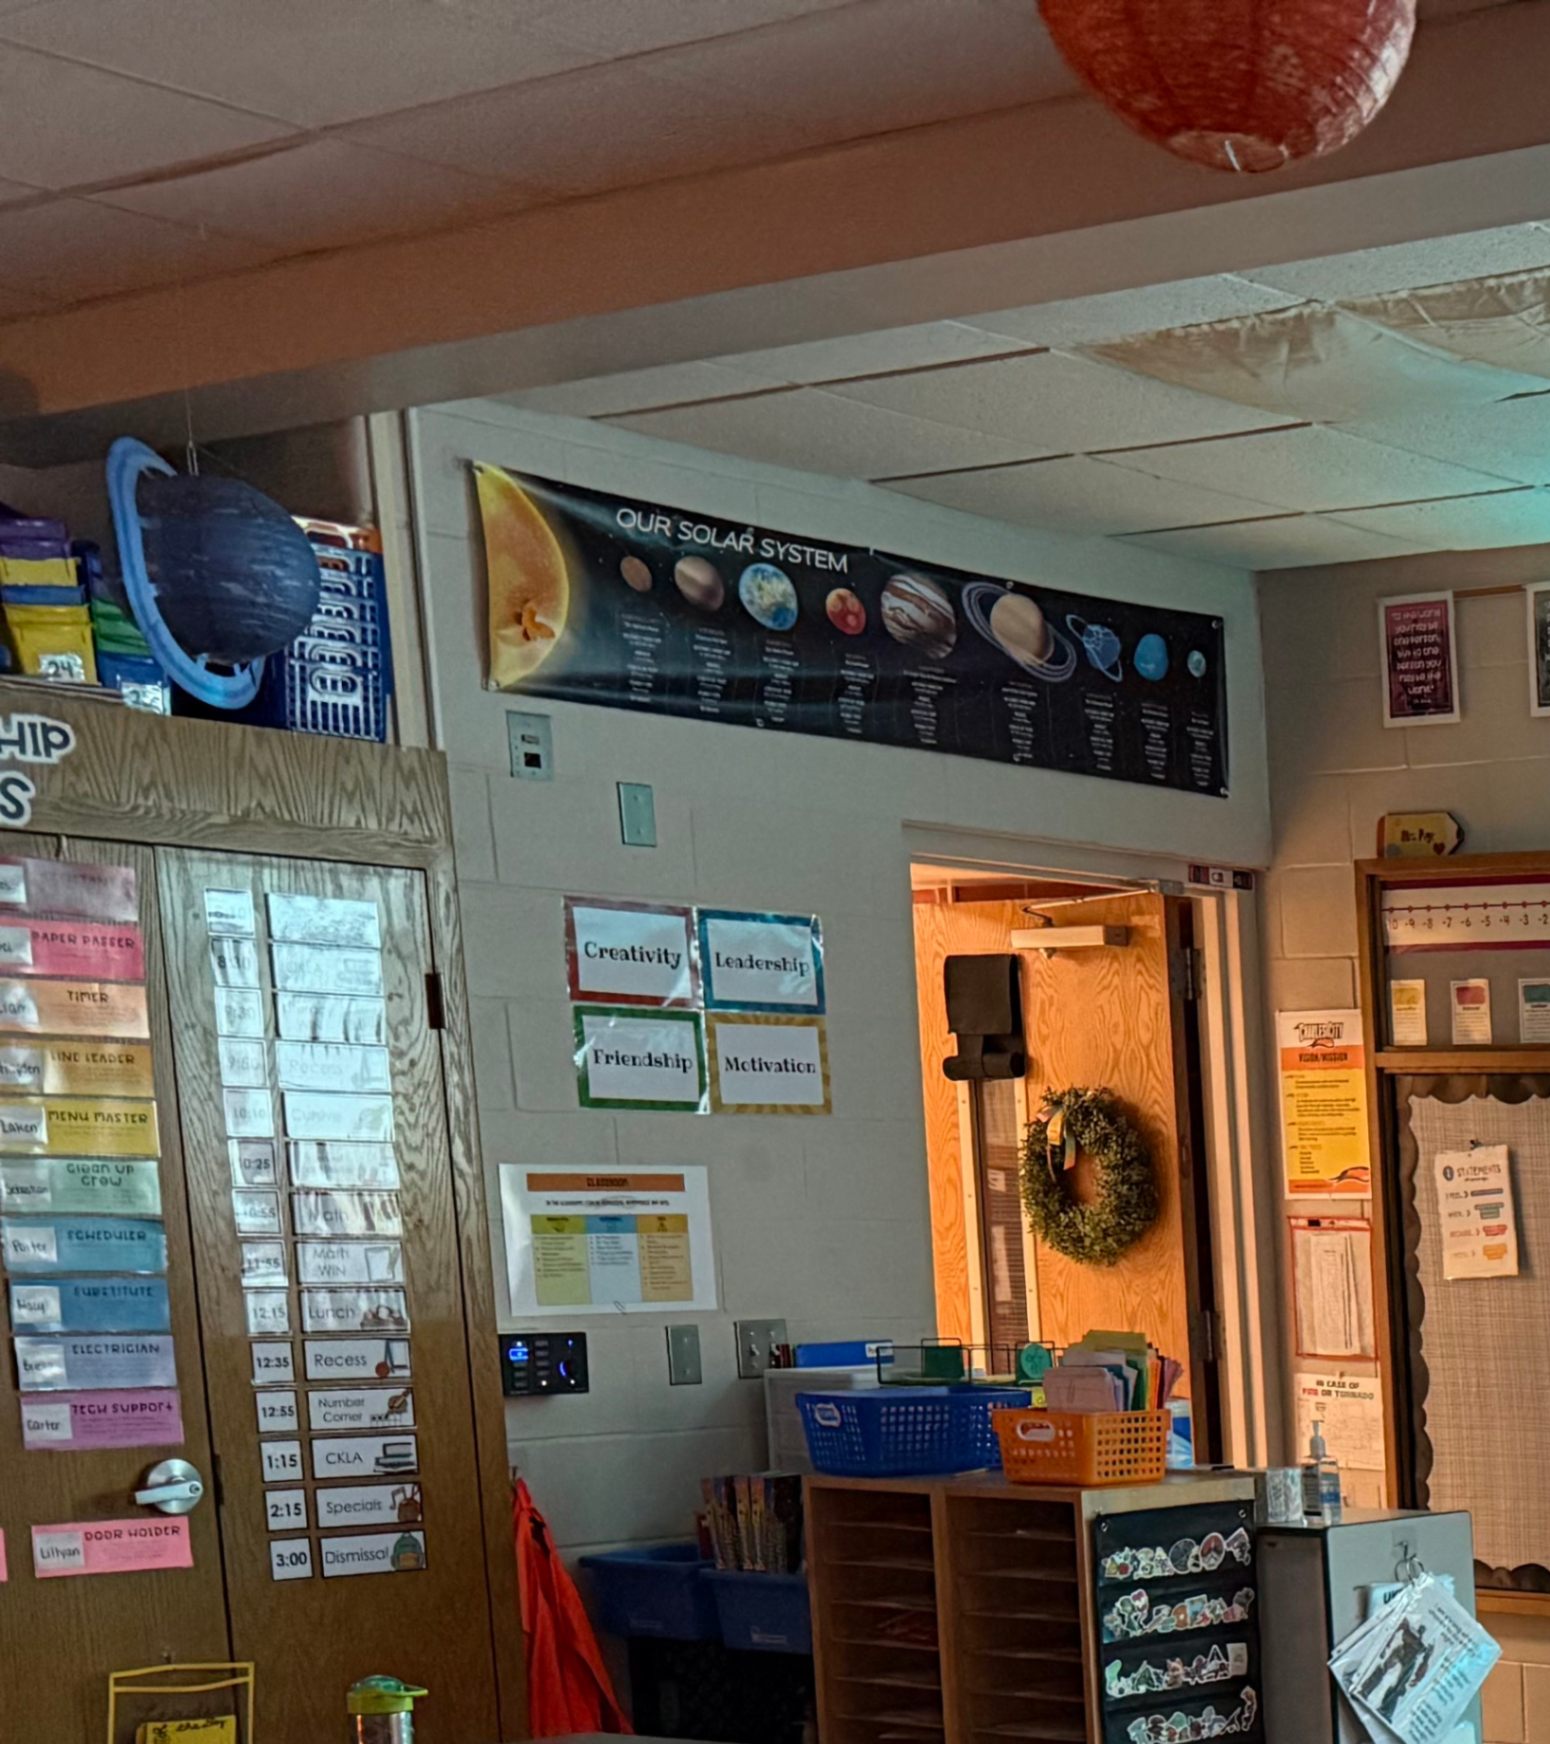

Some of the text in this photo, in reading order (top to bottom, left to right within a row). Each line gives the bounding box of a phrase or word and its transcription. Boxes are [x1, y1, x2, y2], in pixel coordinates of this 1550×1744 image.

[616, 508, 848, 573] OUR SOLAR SYSTEM
[0, 777, 31, 819] S
[31, 930, 77, 946] PAPER
[584, 941, 681, 969] Creativity
[715, 952, 810, 976] Leadership
[593, 1049, 693, 1073] Friendship
[725, 1056, 816, 1074] Motivation
[252, 1304, 355, 1320] 12:15 Lunch
[256, 1353, 367, 1369] 12:35 Recess
[261, 1398, 365, 1418] 12:55 Number
[267, 1452, 363, 1469] 1:15 CKLA
[270, 1499, 383, 1517] 2:15 Specials
[85, 1528, 123, 1541] DOOR
[276, 1546, 389, 1567] 3:00 Dismissal
